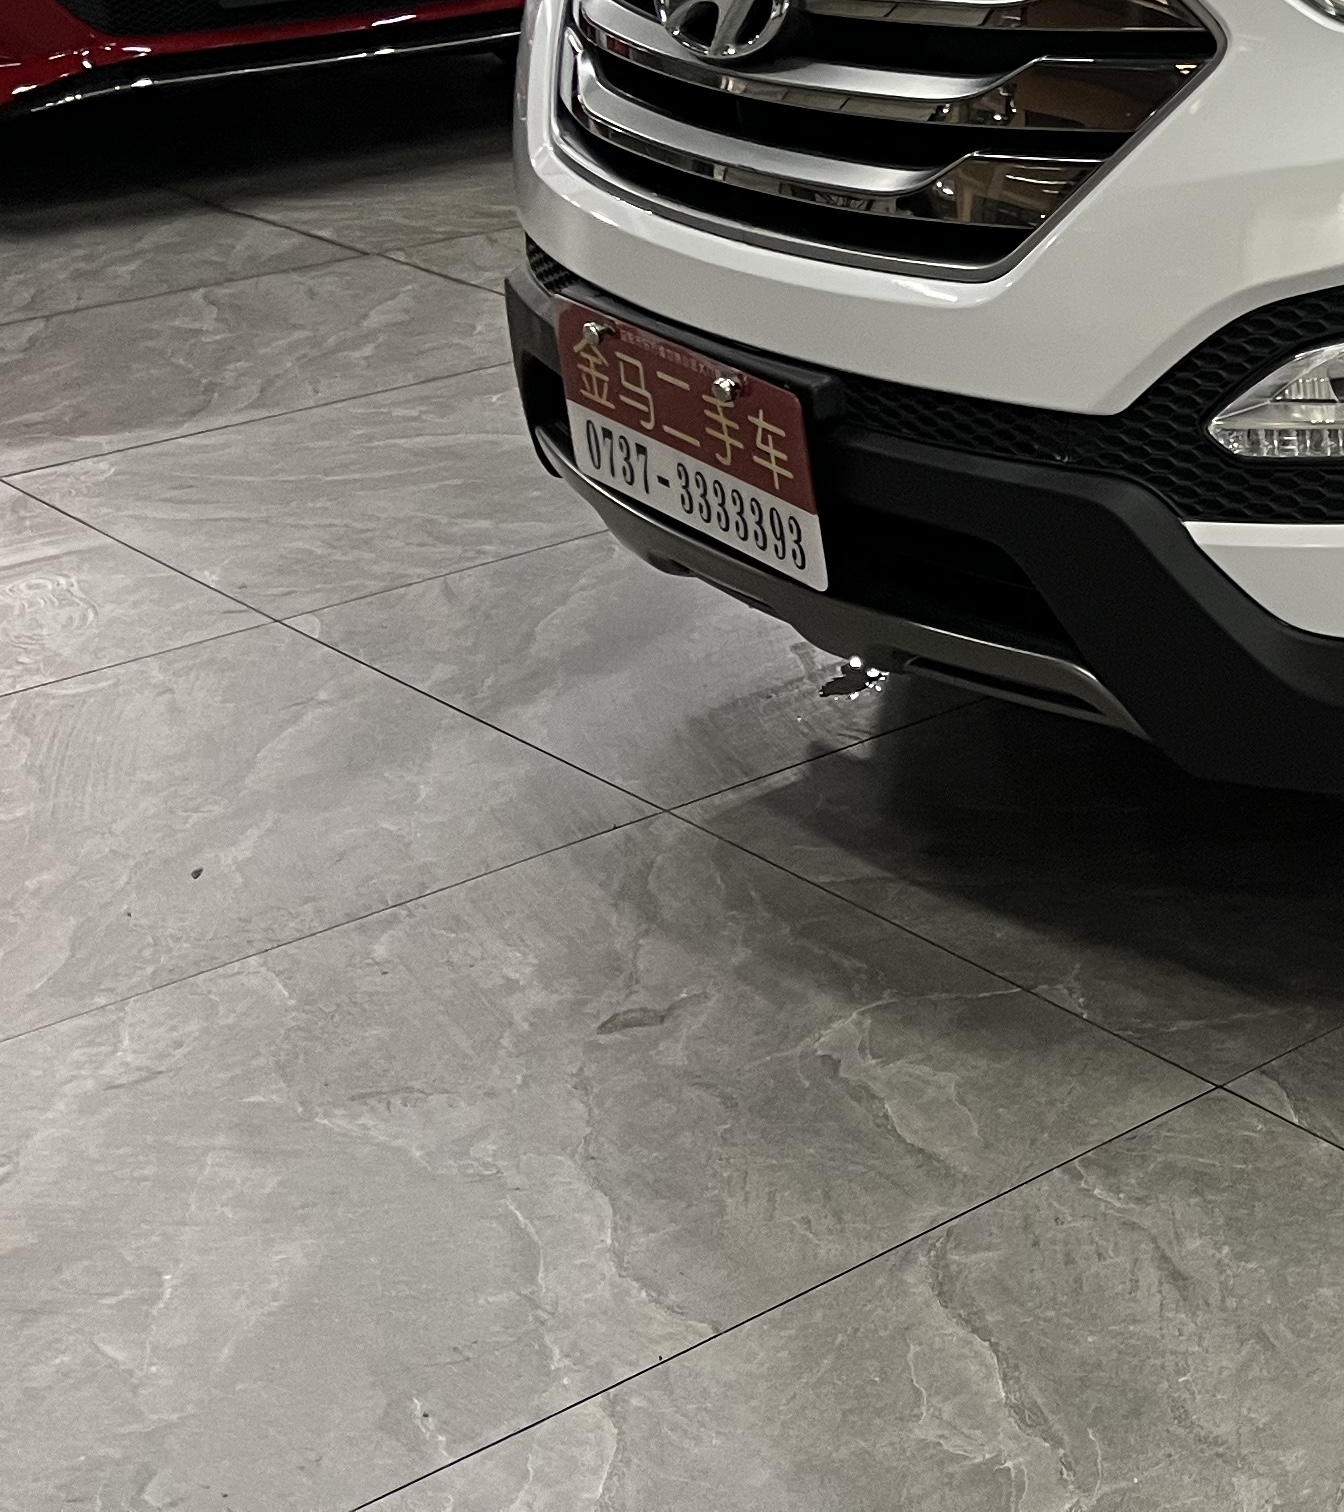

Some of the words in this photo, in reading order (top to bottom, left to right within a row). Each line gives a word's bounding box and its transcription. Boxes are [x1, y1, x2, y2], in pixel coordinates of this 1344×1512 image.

[574, 338, 795, 490] 金马二手车
[585, 419, 807, 571] 0737-3333393
